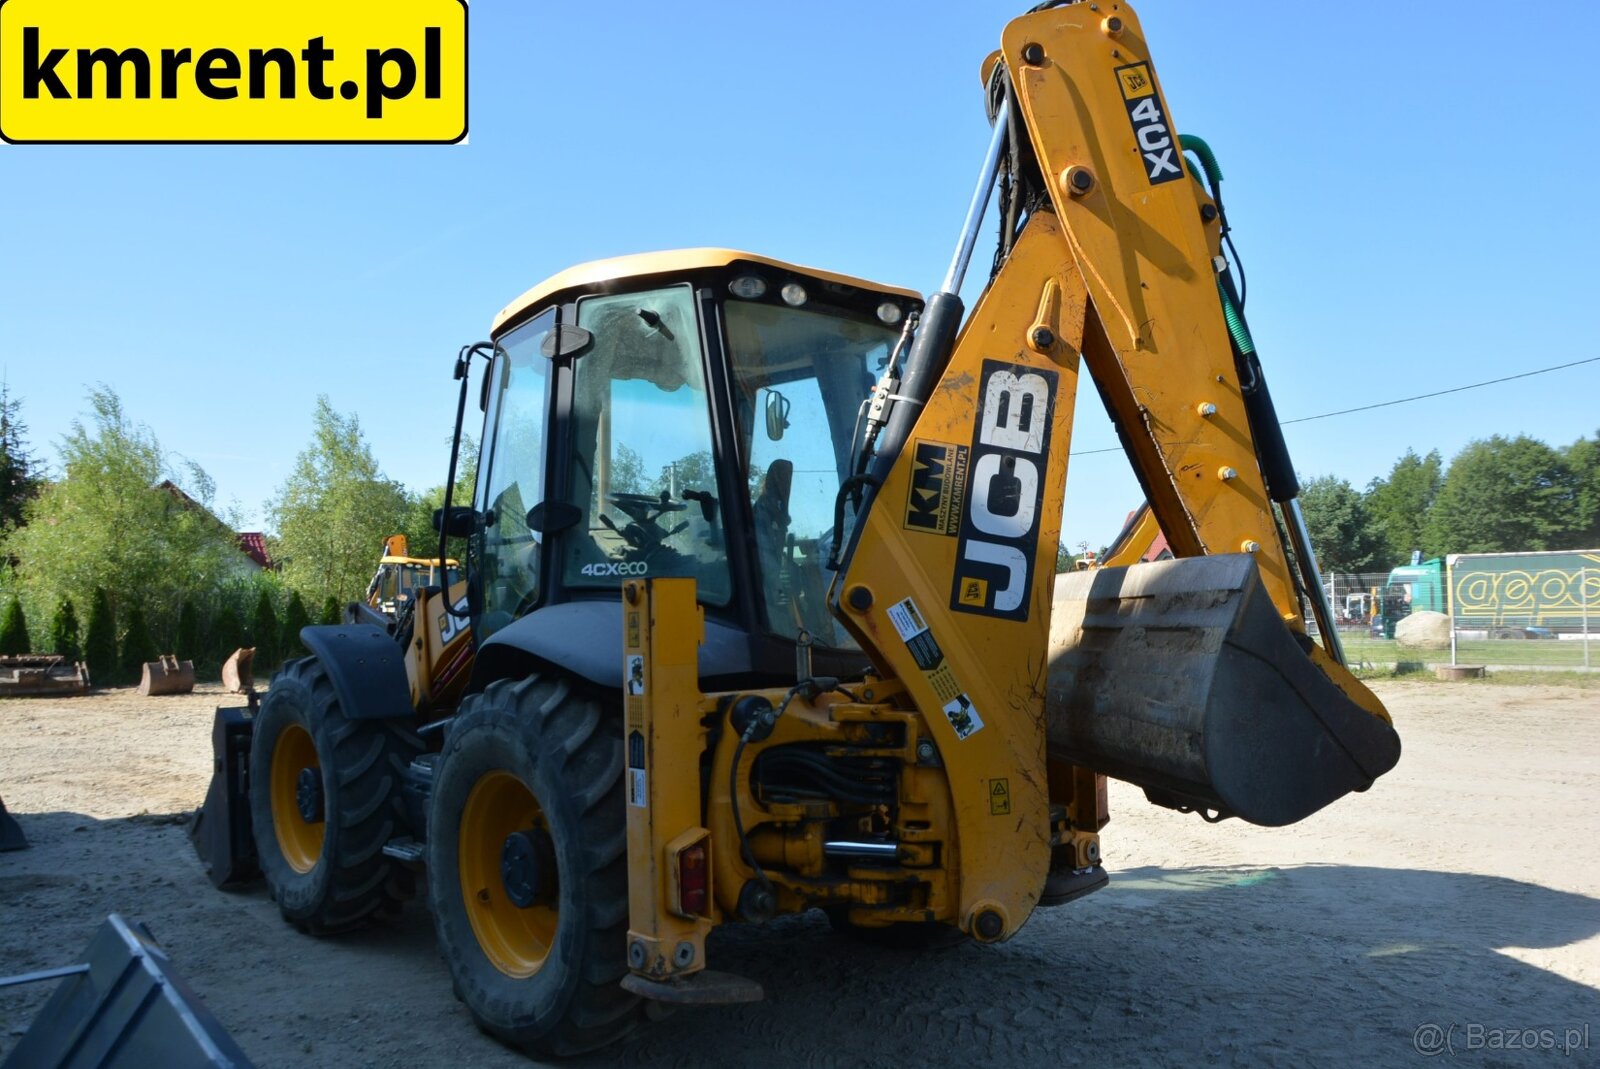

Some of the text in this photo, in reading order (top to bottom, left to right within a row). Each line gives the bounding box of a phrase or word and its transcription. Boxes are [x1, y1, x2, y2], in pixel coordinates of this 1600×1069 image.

[1131, 98, 1181, 178] 4CX
[907, 443, 947, 529] KM
[938, 447, 955, 531] MASZYNY BUDOWLANE
[948, 448, 968, 534] WWW.KMRENT.PL
[964, 370, 1049, 612] JCB
[581, 561, 648, 576] 4CXeco
